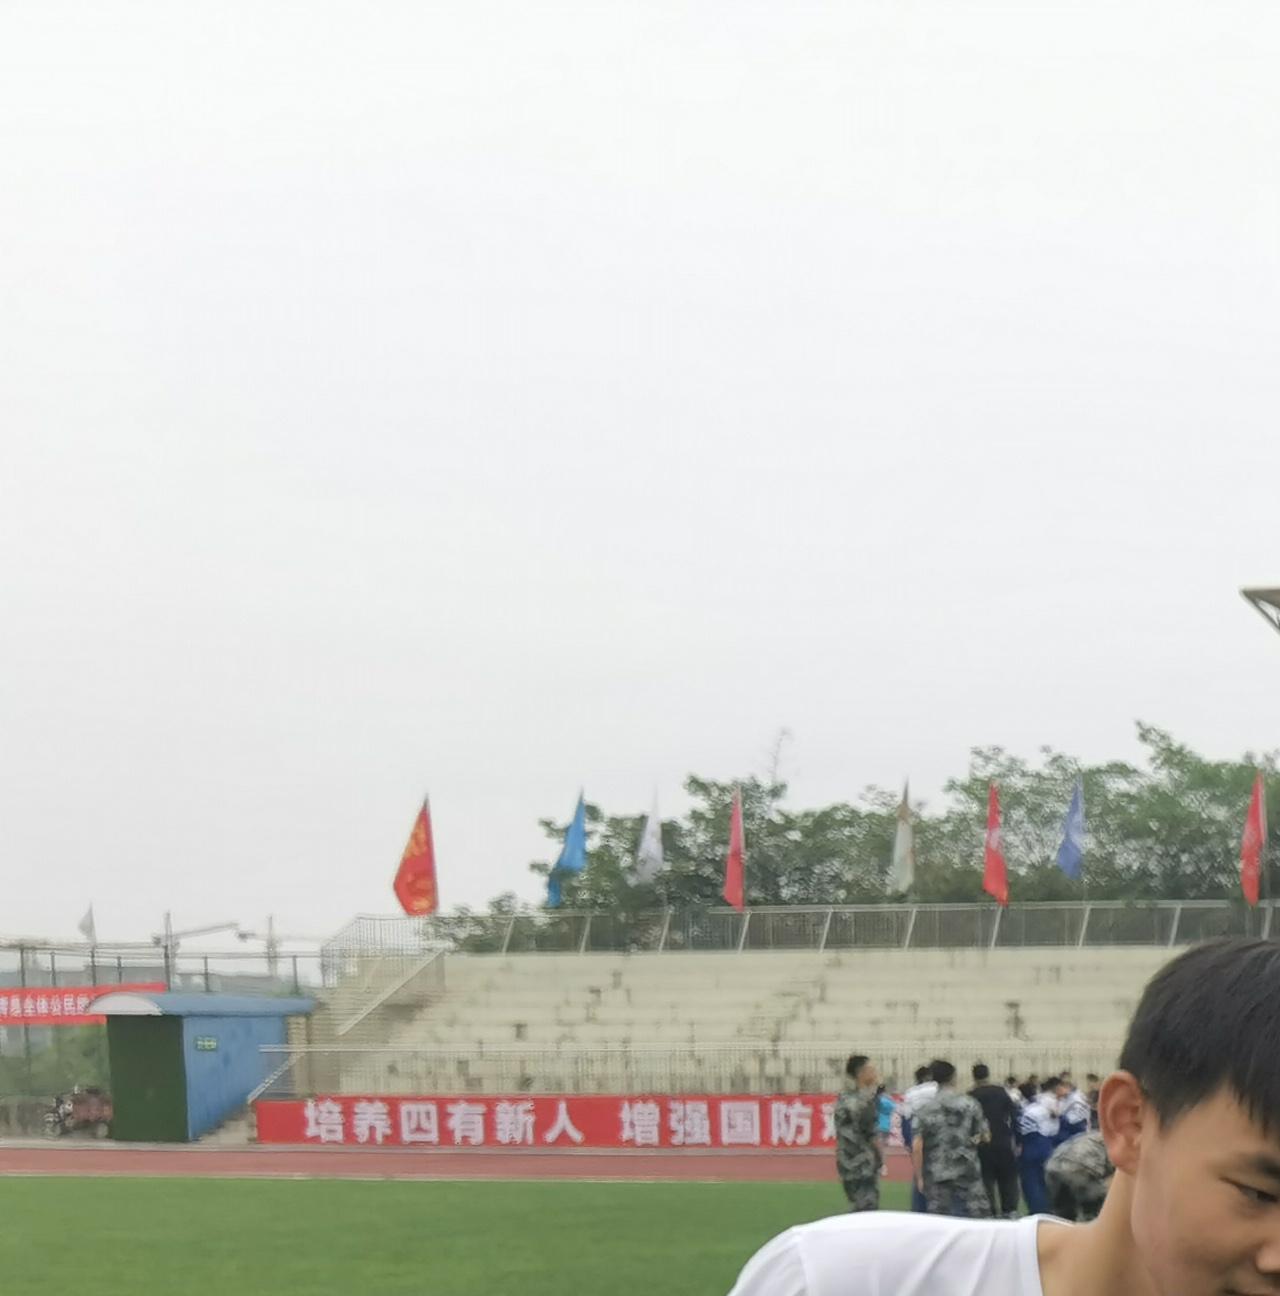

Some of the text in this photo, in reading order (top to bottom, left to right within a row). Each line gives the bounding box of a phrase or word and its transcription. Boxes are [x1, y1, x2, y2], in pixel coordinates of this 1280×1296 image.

[304, 1100, 585, 1145] 培养四有新人
